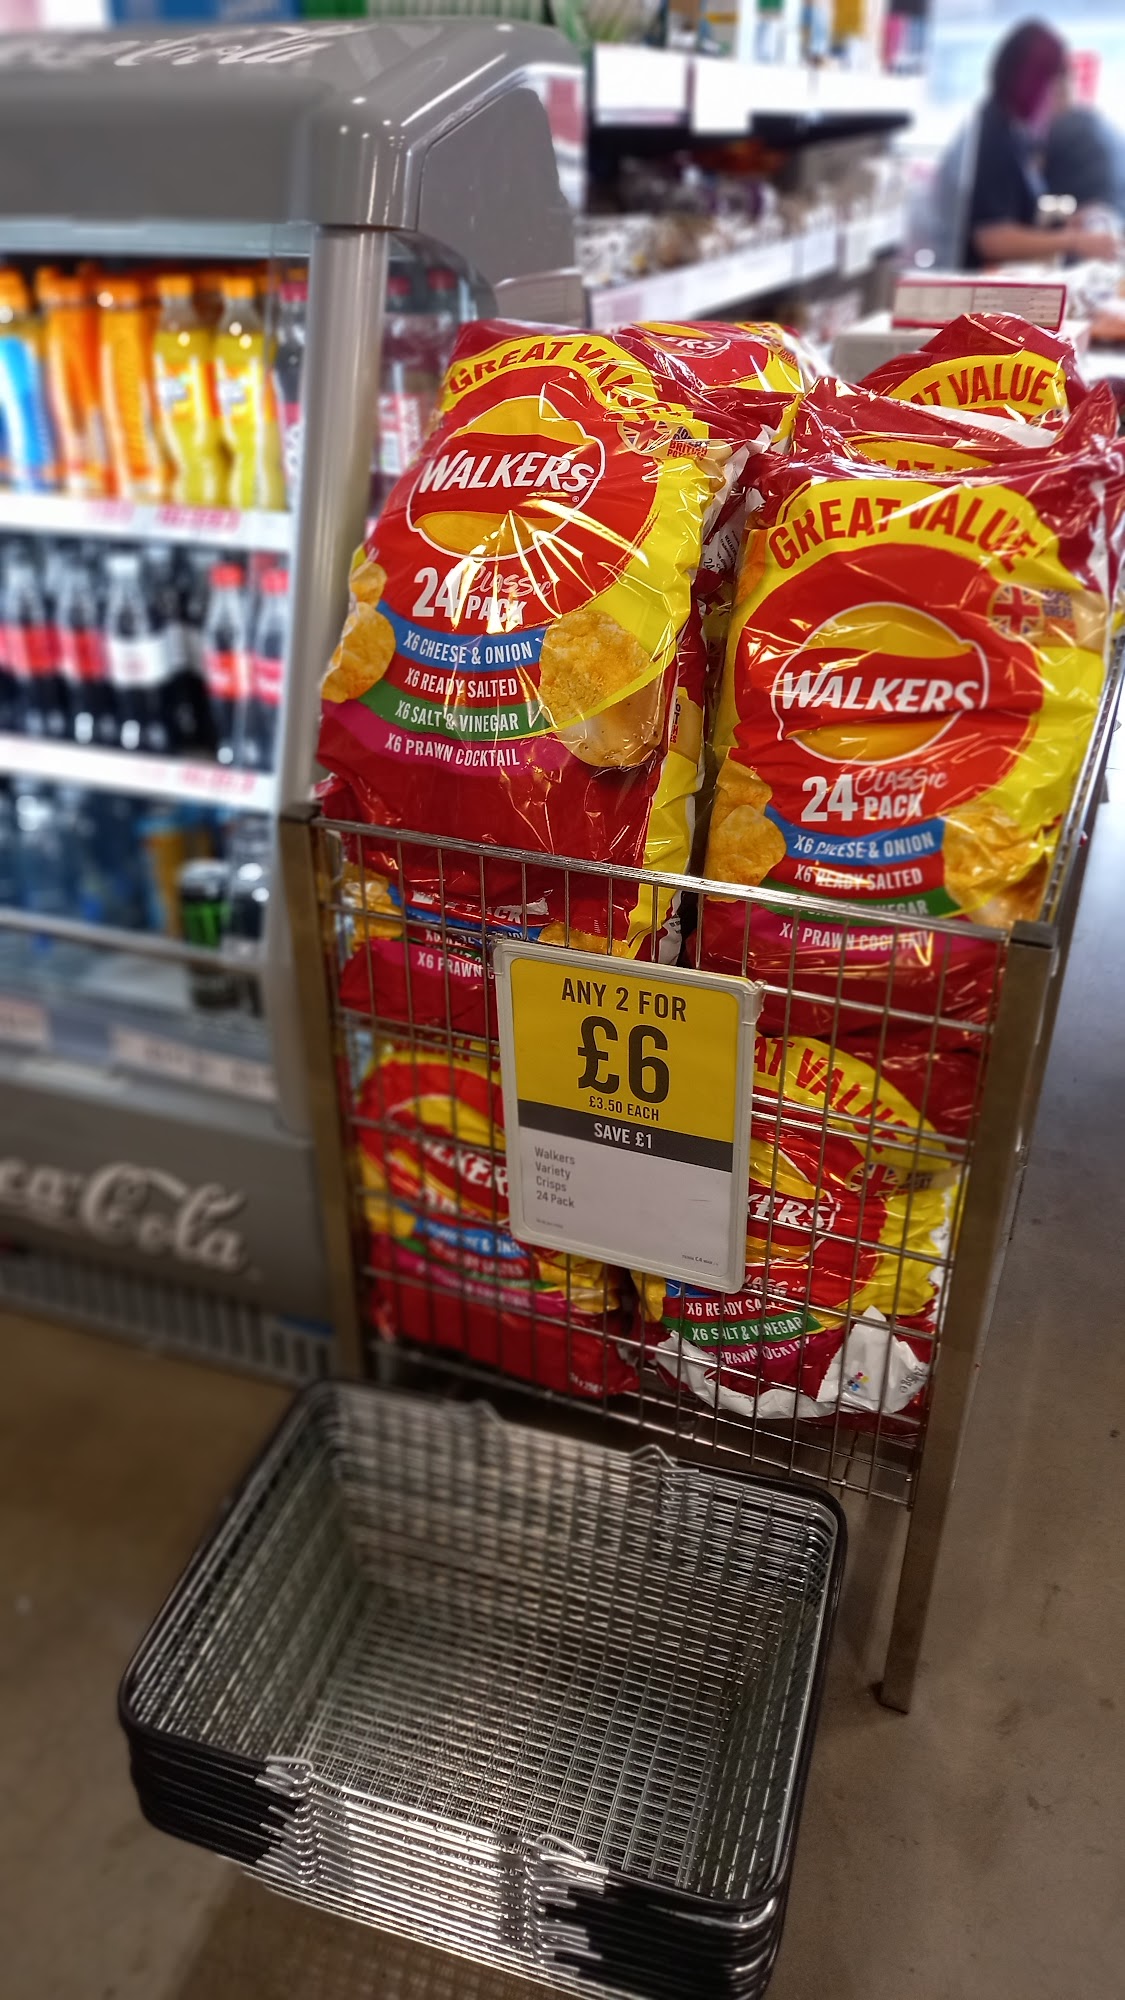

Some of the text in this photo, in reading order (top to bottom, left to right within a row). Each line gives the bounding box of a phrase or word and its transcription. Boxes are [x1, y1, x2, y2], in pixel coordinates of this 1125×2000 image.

[449, 342, 573, 394] GREAT
[948, 363, 1055, 406] VALUE
[419, 450, 594, 493] WALKERS
[768, 497, 901, 569] GREAT
[909, 494, 1038, 573] VALUE
[412, 567, 527, 625] 24 PACK
[403, 631, 533, 665] X6 CHEESE & ONION
[405, 668, 518, 698] X6 READY SALTED
[781, 667, 980, 713] WALKERS
[395, 700, 519, 733] X6 SALT & VINEGAR
[385, 733, 520, 767] X6 PRAWN COCKTAIL
[801, 774, 923, 822] 24 PACK
[793, 832, 935, 859] X6 CHEESE & ONION
[795, 864, 812, 882] X6
[868, 868, 923, 891] SALTED
[802, 928, 855, 950] PRAWN
[417, 951, 434, 969] X6
[562, 977, 687, 1022] ANY 2 FOR
[578, 1015, 670, 1104] £6
[589, 1095, 659, 1121] £3.50 EACH
[594, 1122, 652, 1149] SAVE £1
[534, 1146, 576, 1166] Walkers
[535, 1161, 571, 1181] Variety
[535, 1176, 567, 1193] Crisps
[536, 1190, 575, 1208] 24 Pack
[686, 1303, 703, 1317] X6
[692, 1327, 708, 1342] X6
[741, 1326, 751, 1341] &
